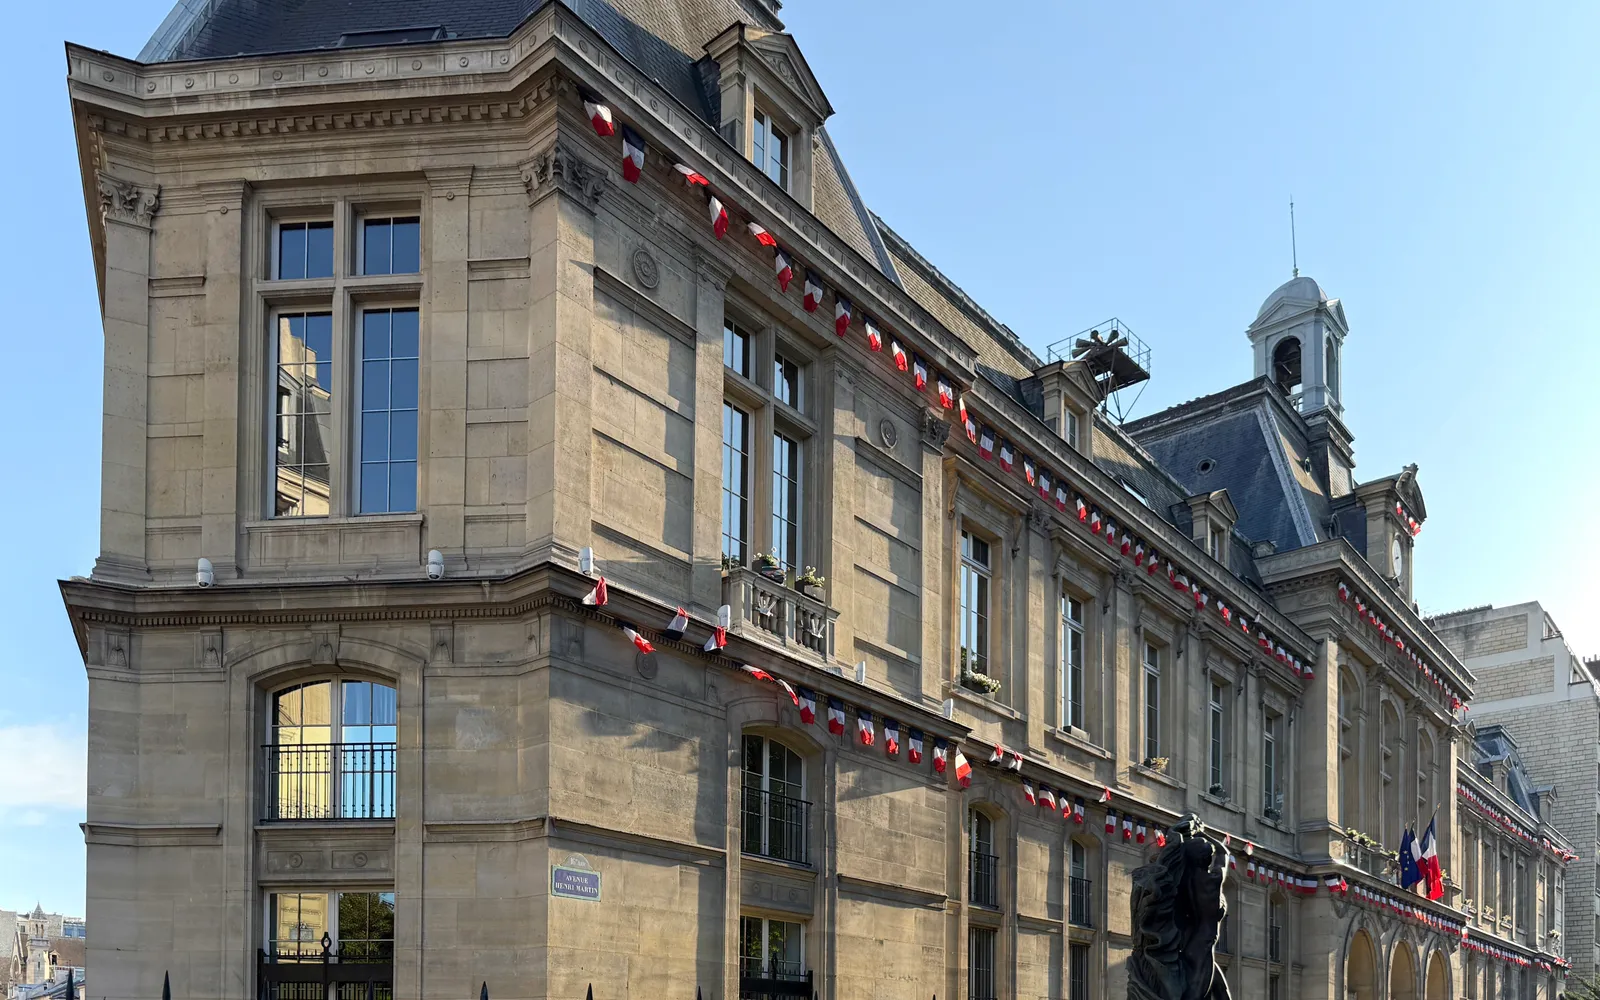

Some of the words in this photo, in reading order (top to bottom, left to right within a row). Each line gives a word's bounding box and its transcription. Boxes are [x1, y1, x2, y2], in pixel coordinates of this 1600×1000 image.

[566, 875, 588, 884] AVENUE
[555, 882, 574, 890] HENRI
[576, 885, 598, 894] MARTIN
